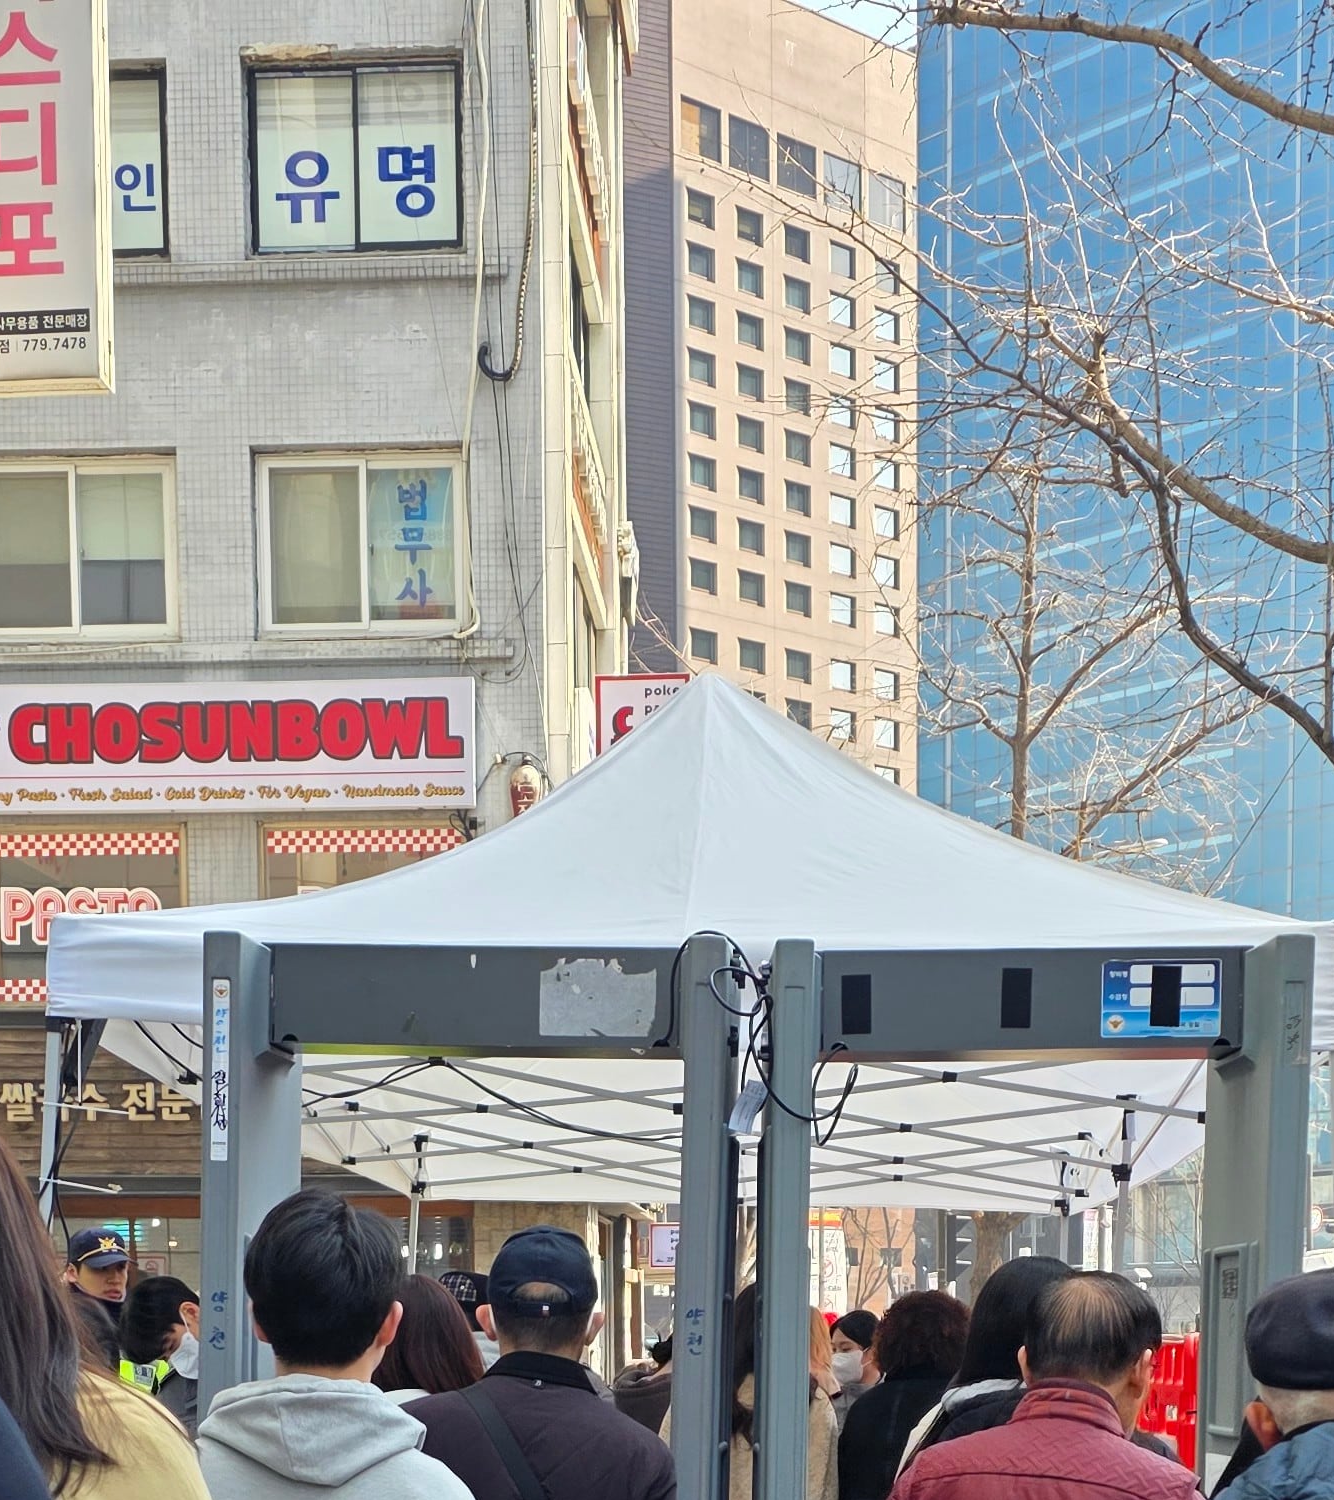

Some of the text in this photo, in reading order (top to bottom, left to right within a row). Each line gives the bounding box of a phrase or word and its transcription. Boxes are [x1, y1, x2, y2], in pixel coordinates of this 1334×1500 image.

[42, 313, 88, 329] 전문매장
[22, 337, 87, 352] 779.7478
[394, 479, 434, 608] 법무사
[8, 696, 465, 765] CHOSUNBOWL
[17, 787, 57, 802] Pasta
[69, 786, 107, 801] Fresh
[110, 786, 154, 801] Salad
[164, 785, 195, 800] Cold
[198, 785, 246, 801] Drinks
[257, 784, 281, 800] For
[283, 784, 331, 803] Vegan
[342, 783, 420, 798] Handmade
[423, 782, 465, 798] Sauce
[121, 1081, 202, 1122] 전문
